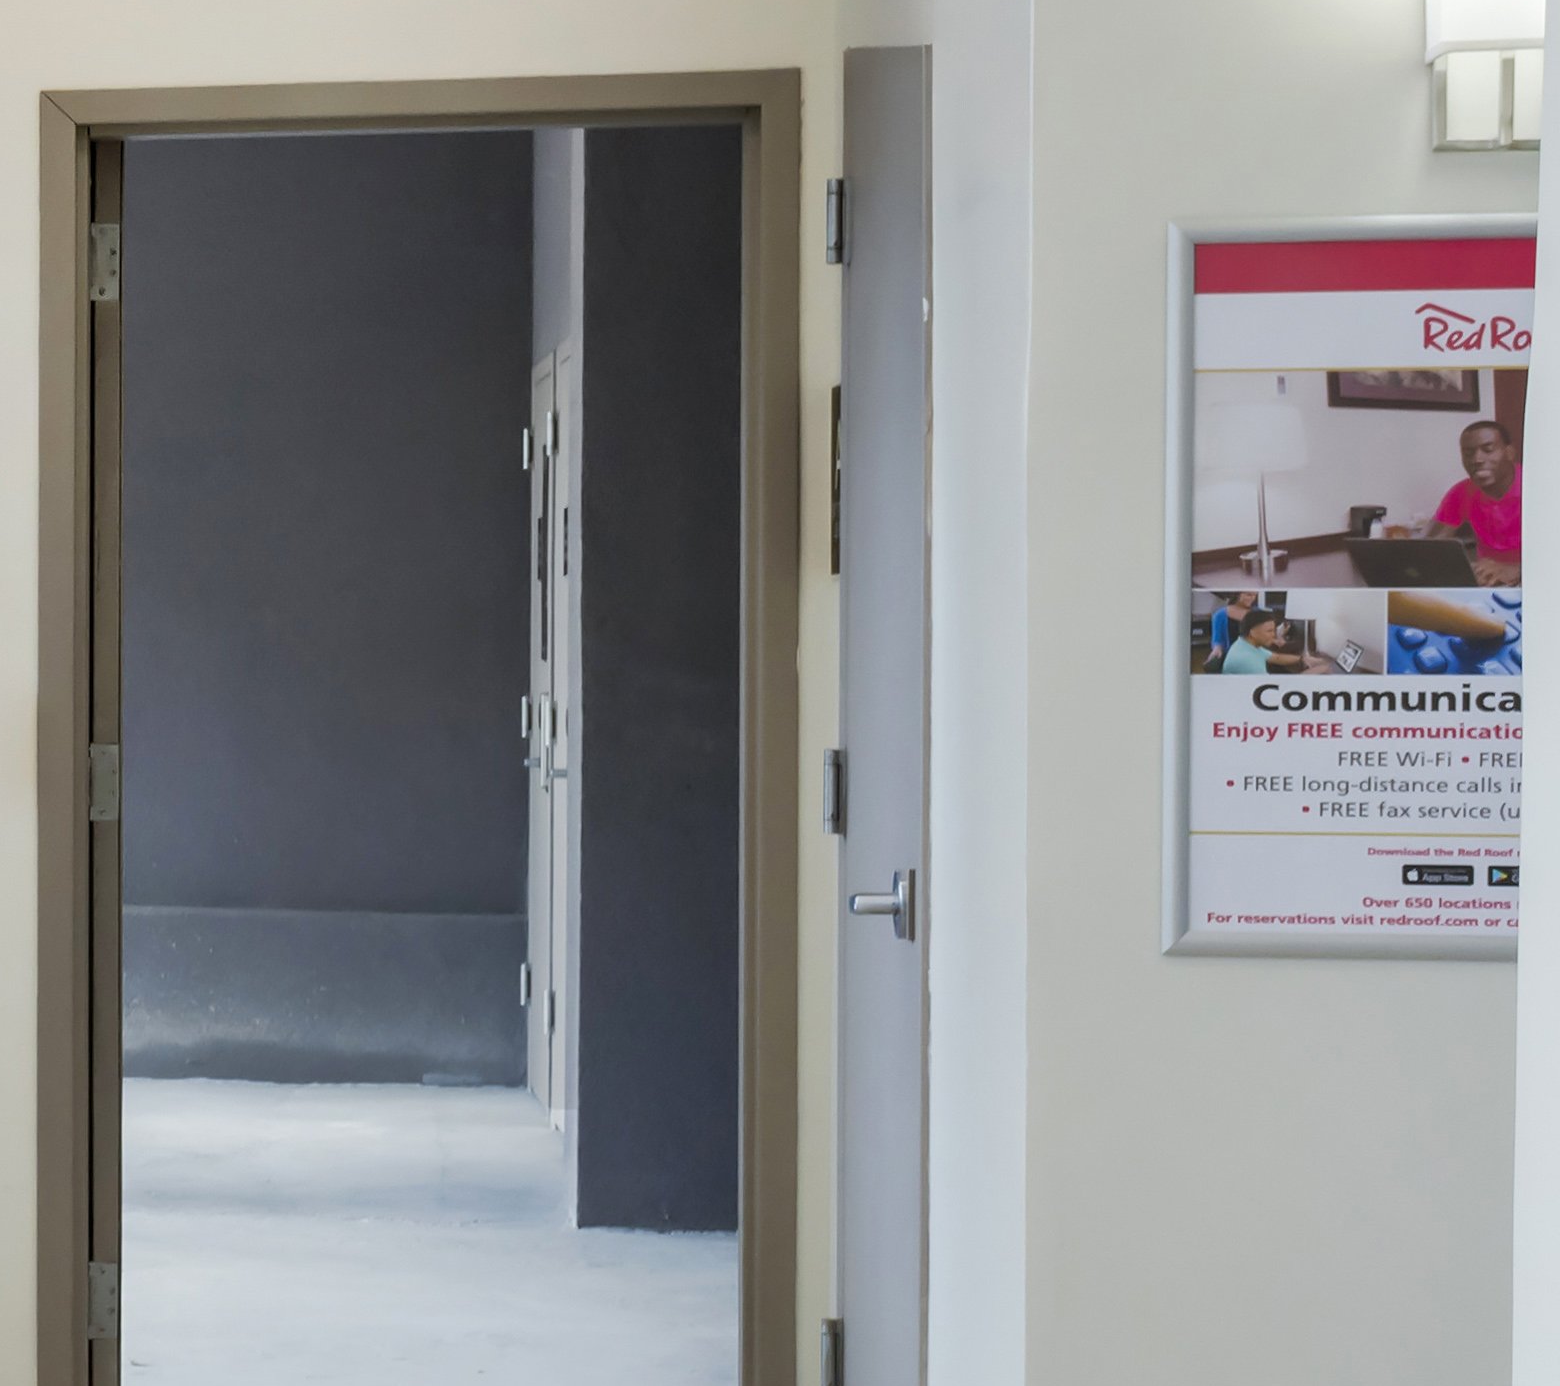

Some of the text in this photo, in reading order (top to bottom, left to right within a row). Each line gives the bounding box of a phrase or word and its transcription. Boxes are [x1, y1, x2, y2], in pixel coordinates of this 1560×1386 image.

[1423, 316, 1486, 352] Red
[1212, 722, 1279, 742] Enjoy
[1287, 723, 1343, 738] FREE
[1338, 751, 1522, 768] FREE Wi-Fi FRE
[1243, 776, 1294, 792] FREE
[1301, 776, 1449, 796] long-distance
[1456, 777, 1502, 793] calls
[1319, 801, 1369, 818] FREE
[1378, 801, 1411, 818] fax
[1418, 802, 1492, 819] service
[1367, 847, 1430, 856] Download
[1433, 847, 1454, 856] the
[1457, 848, 1481, 857] Red
[1484, 848, 1514, 857] Roof
[1422, 873, 1442, 883] App
[1362, 896, 1512, 910] Over 650 locations
[1206, 912, 1232, 924] For
[1237, 913, 1336, 925] reservations
[1341, 914, 1375, 926] visit
[1379, 914, 1480, 927] redroof.com
[1484, 917, 1502, 927] or
